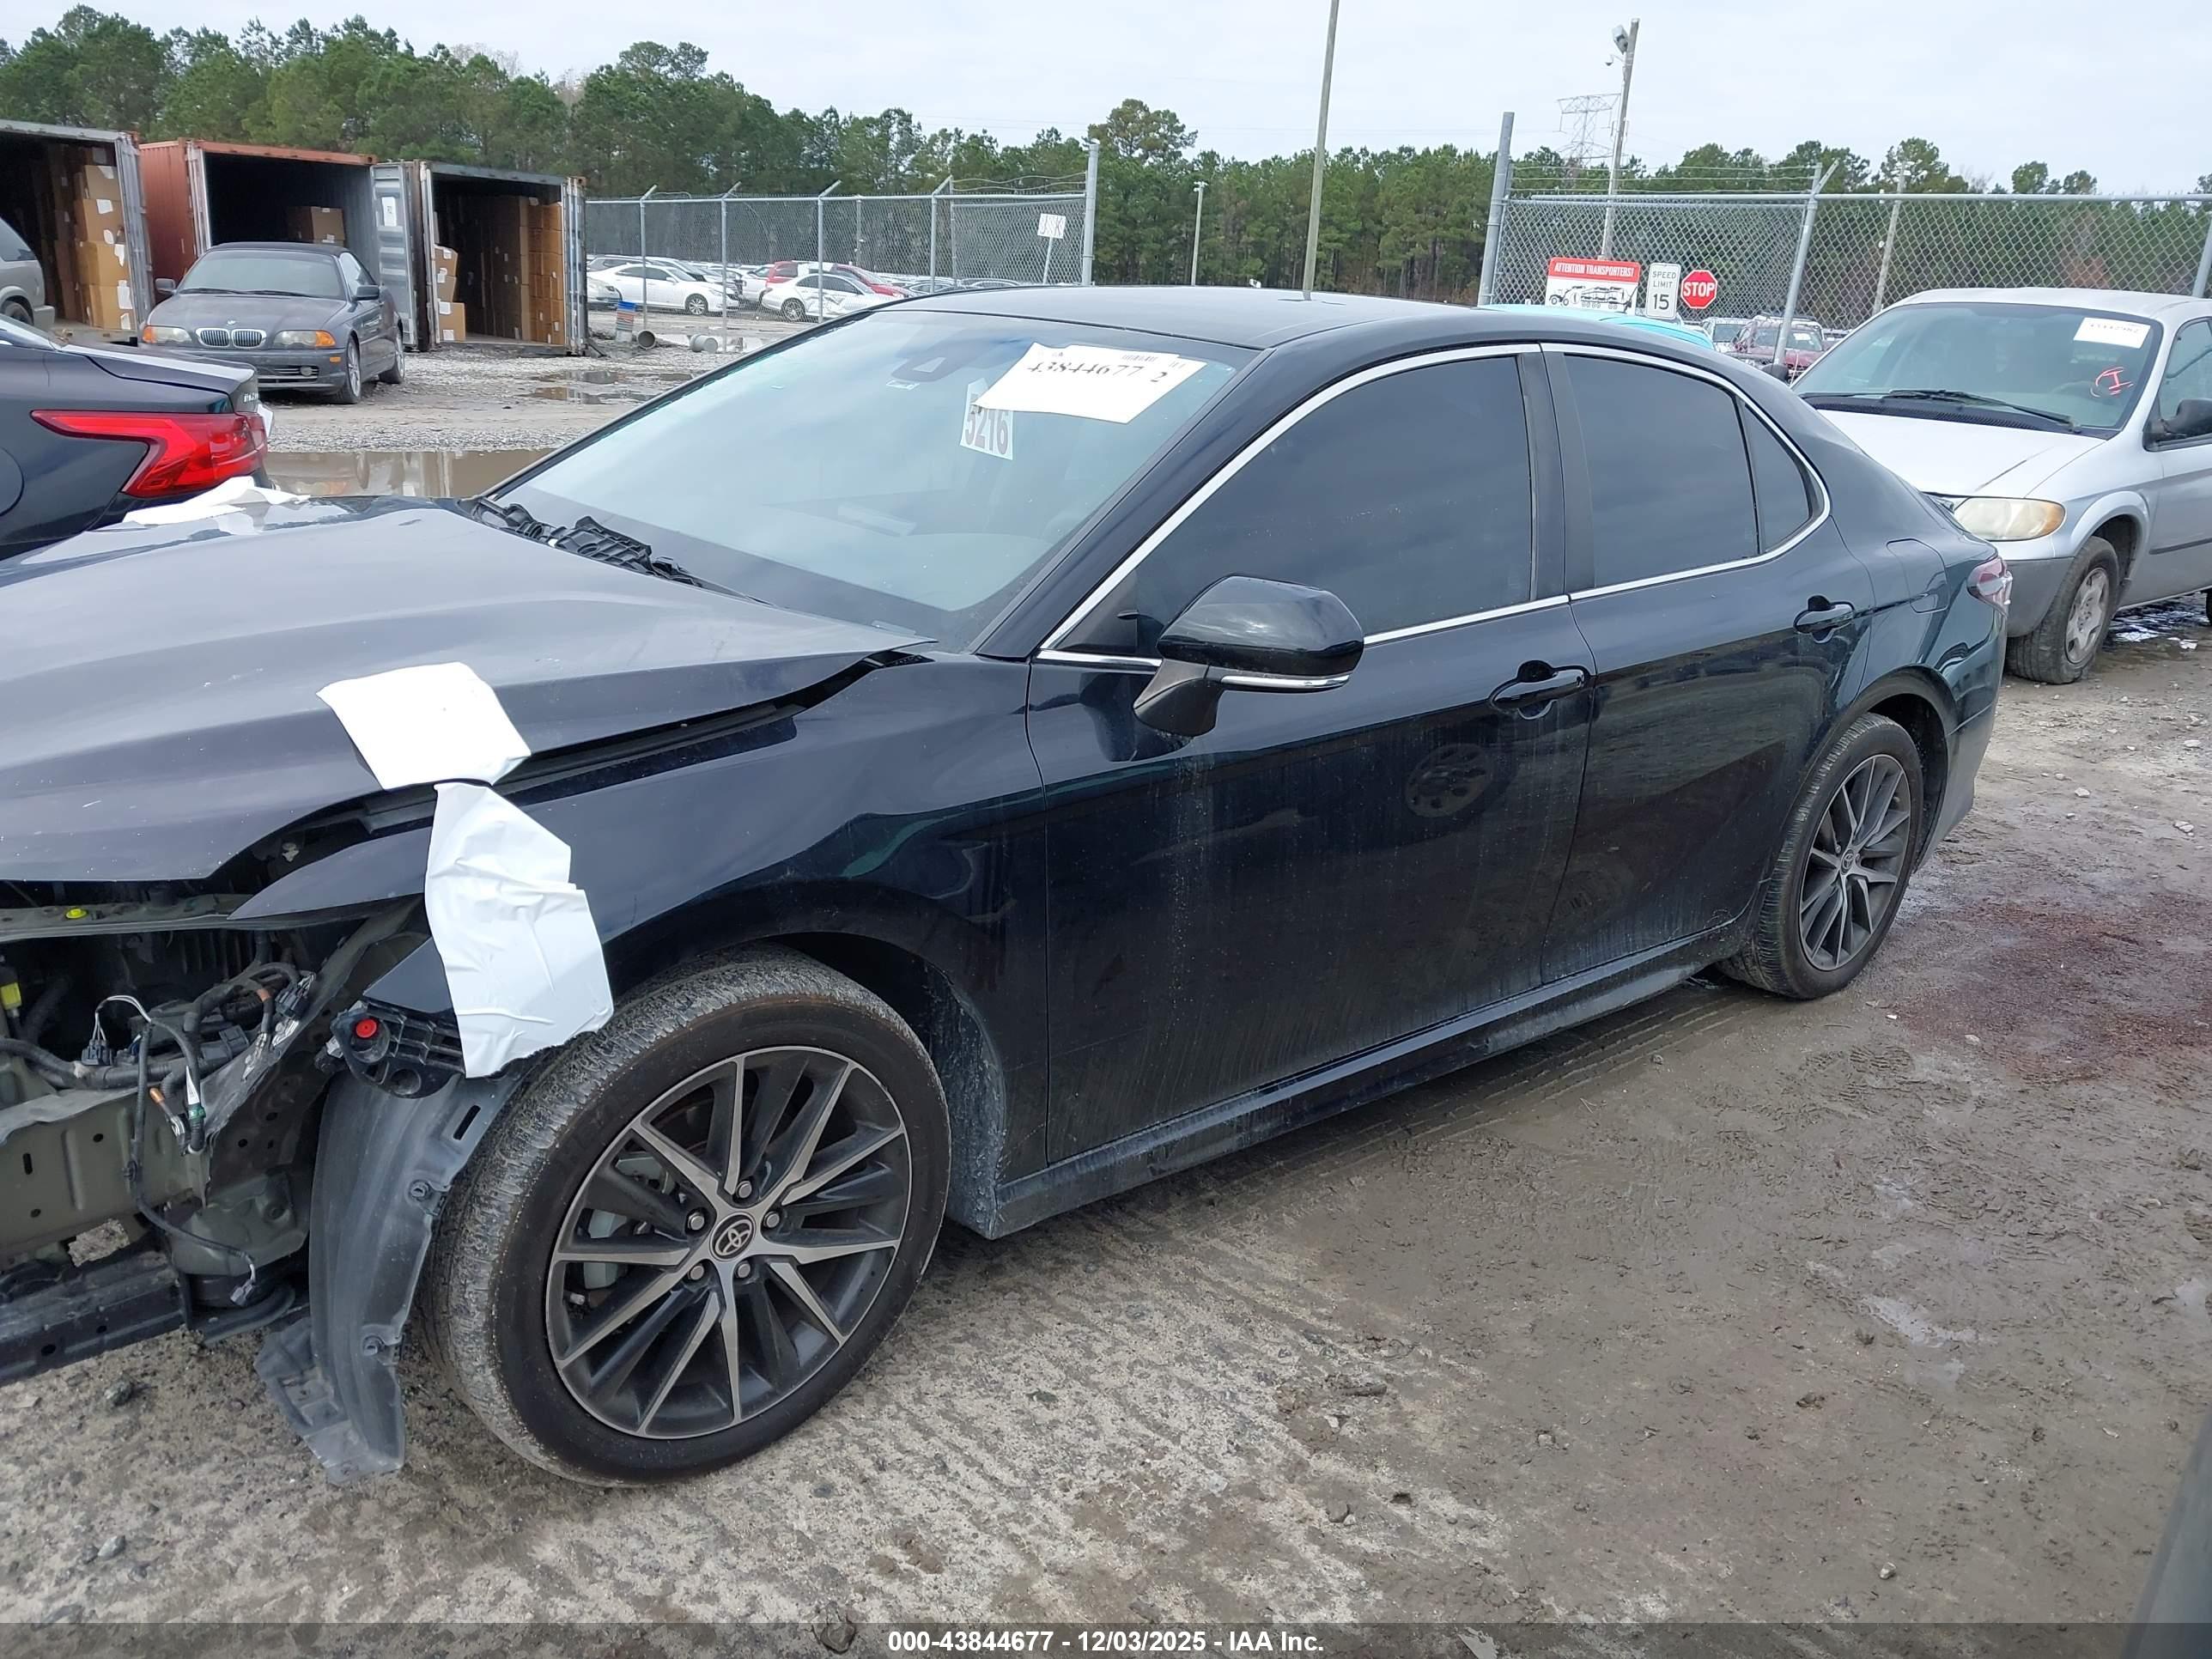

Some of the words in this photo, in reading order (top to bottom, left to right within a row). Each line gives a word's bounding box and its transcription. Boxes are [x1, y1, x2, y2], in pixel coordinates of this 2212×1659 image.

[1554, 262, 1586, 274] ATTENTION
[1586, 264, 1635, 277] TRANSPORTERS!
[1652, 270, 1677, 279] SPEED
[1653, 280, 1674, 289] LIMIT
[1683, 281, 1716, 298] STOP
[1653, 293, 1670, 310] 15
[964, 393, 1009, 456] 5216
